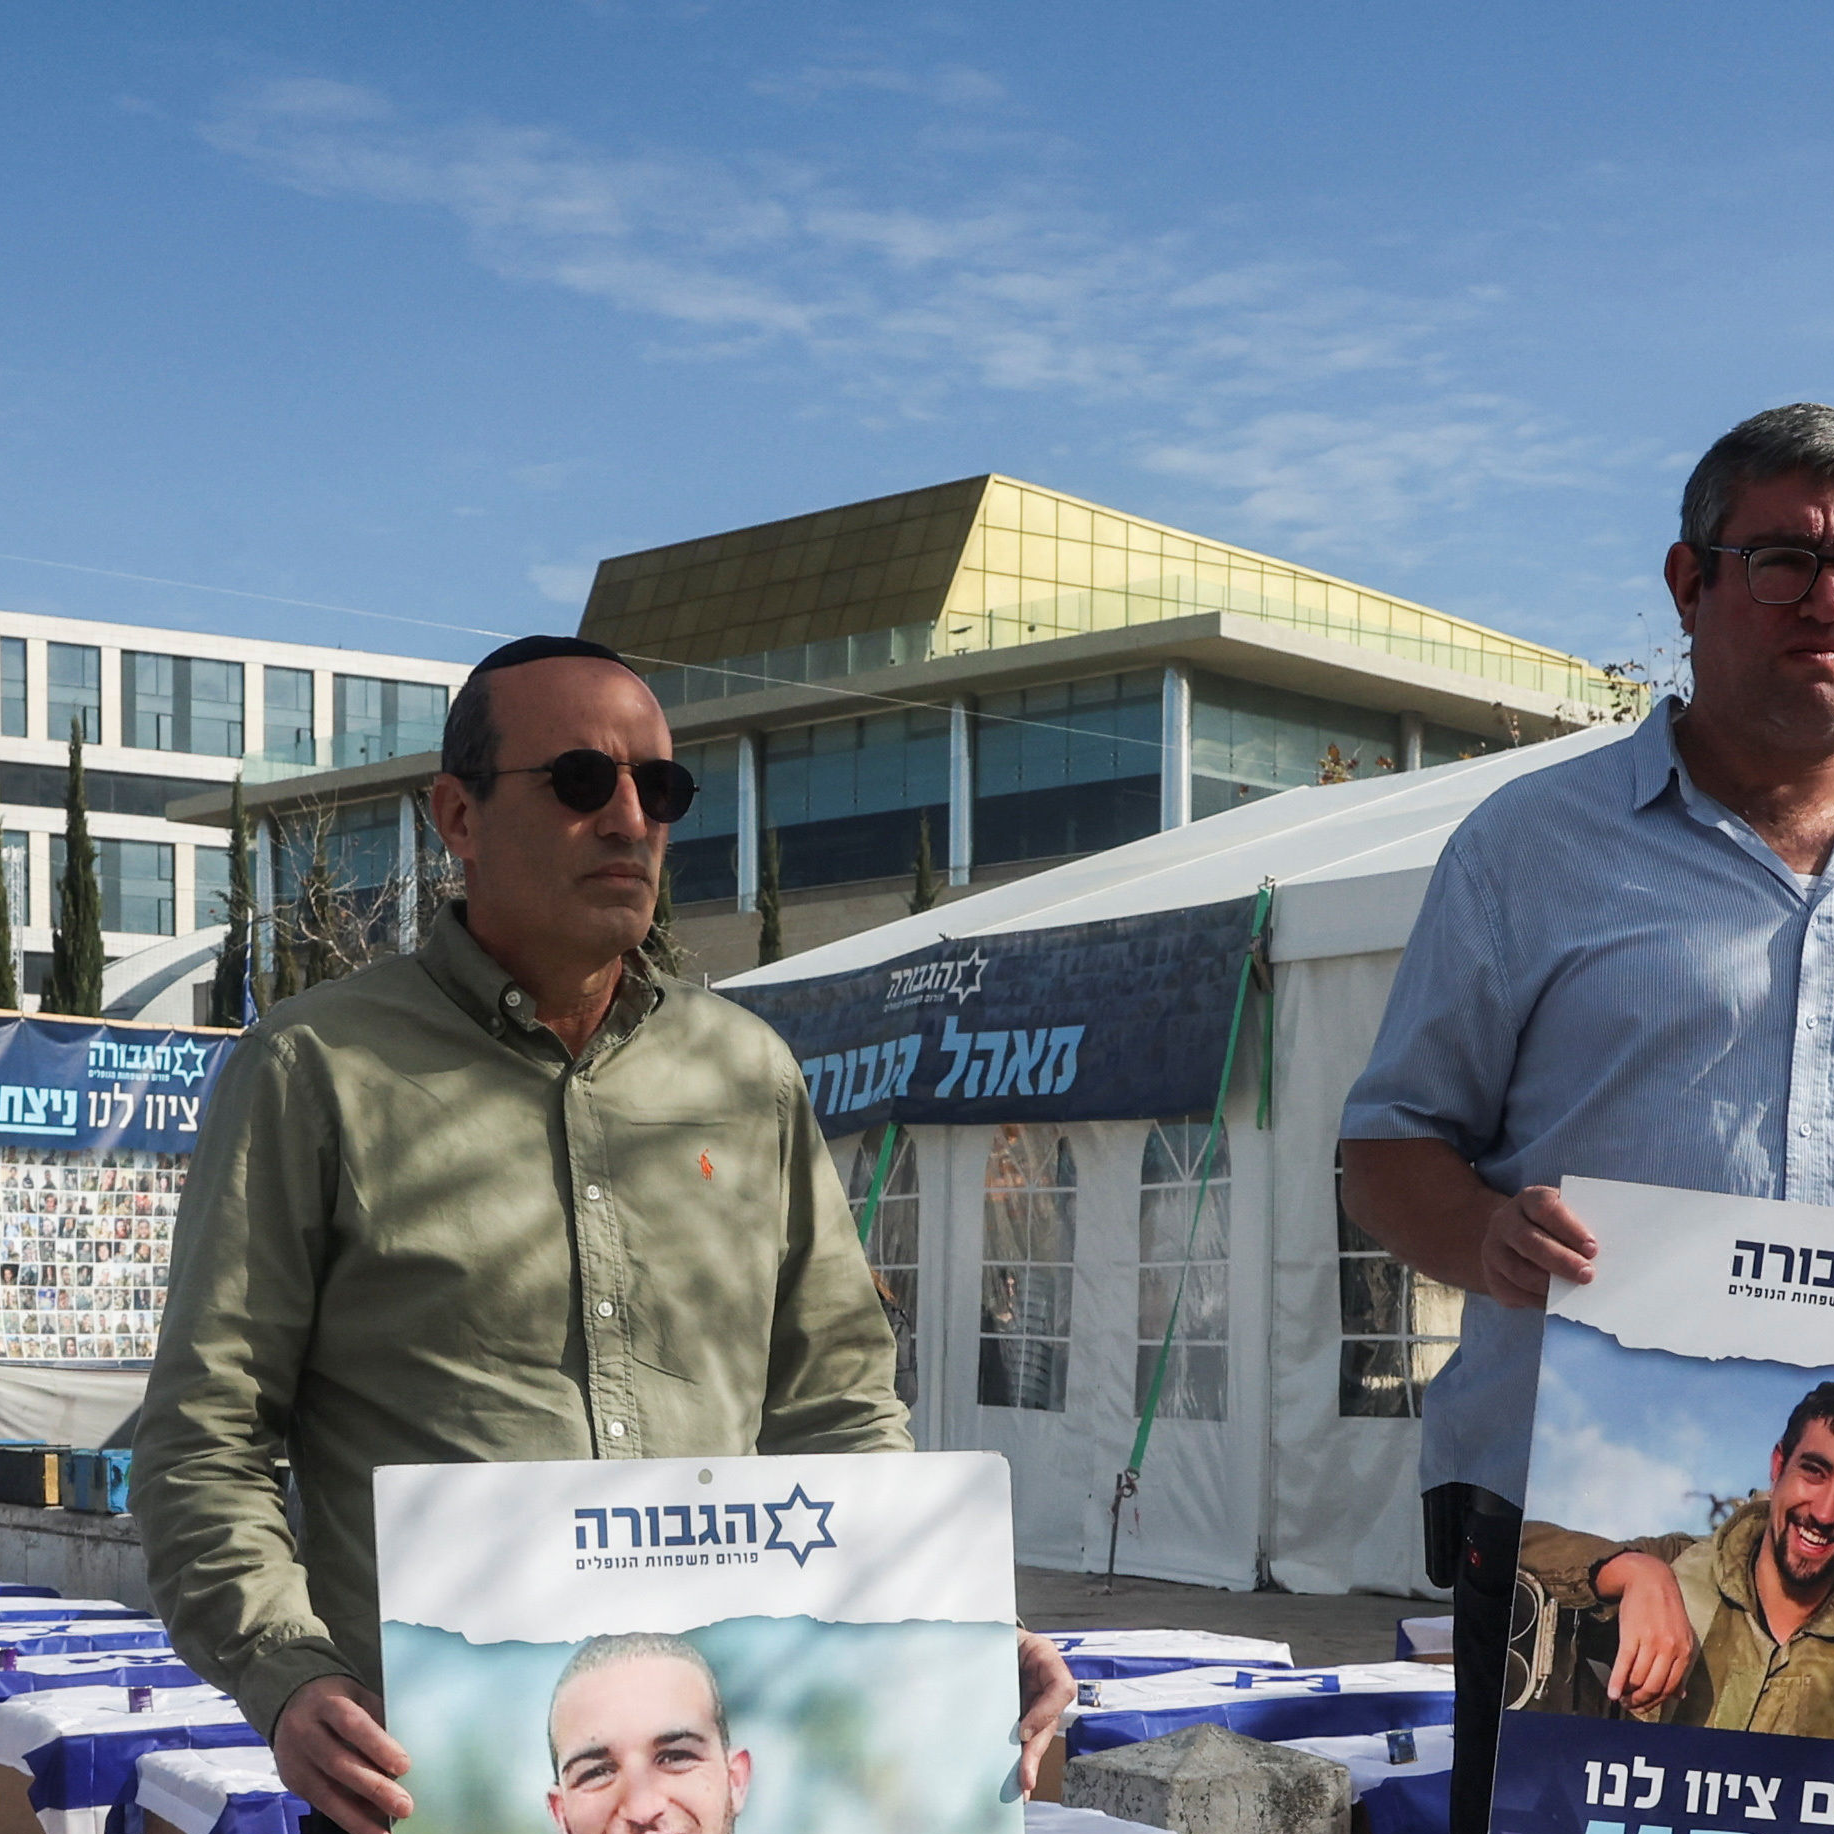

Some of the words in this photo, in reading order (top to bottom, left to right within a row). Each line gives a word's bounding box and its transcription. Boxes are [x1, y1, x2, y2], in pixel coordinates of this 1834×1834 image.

[886, 961, 956, 999] הגבורה
[88, 1040, 172, 1071] הגבורה
[934, 1015, 1086, 1098] מאהל
[88, 1082, 135, 1130] לנו
[145, 1094, 200, 1132] ציוו
[1728, 1284, 1786, 1301] הנופלים
[574, 1503, 758, 1549] הגבורה
[576, 1556, 639, 1570] הנופלים
[645, 1554, 709, 1568] משפחות
[717, 1552, 759, 1566] פורום
[1584, 1755, 1666, 1809] לנו
[1684, 1769, 1783, 1821] ציוו
